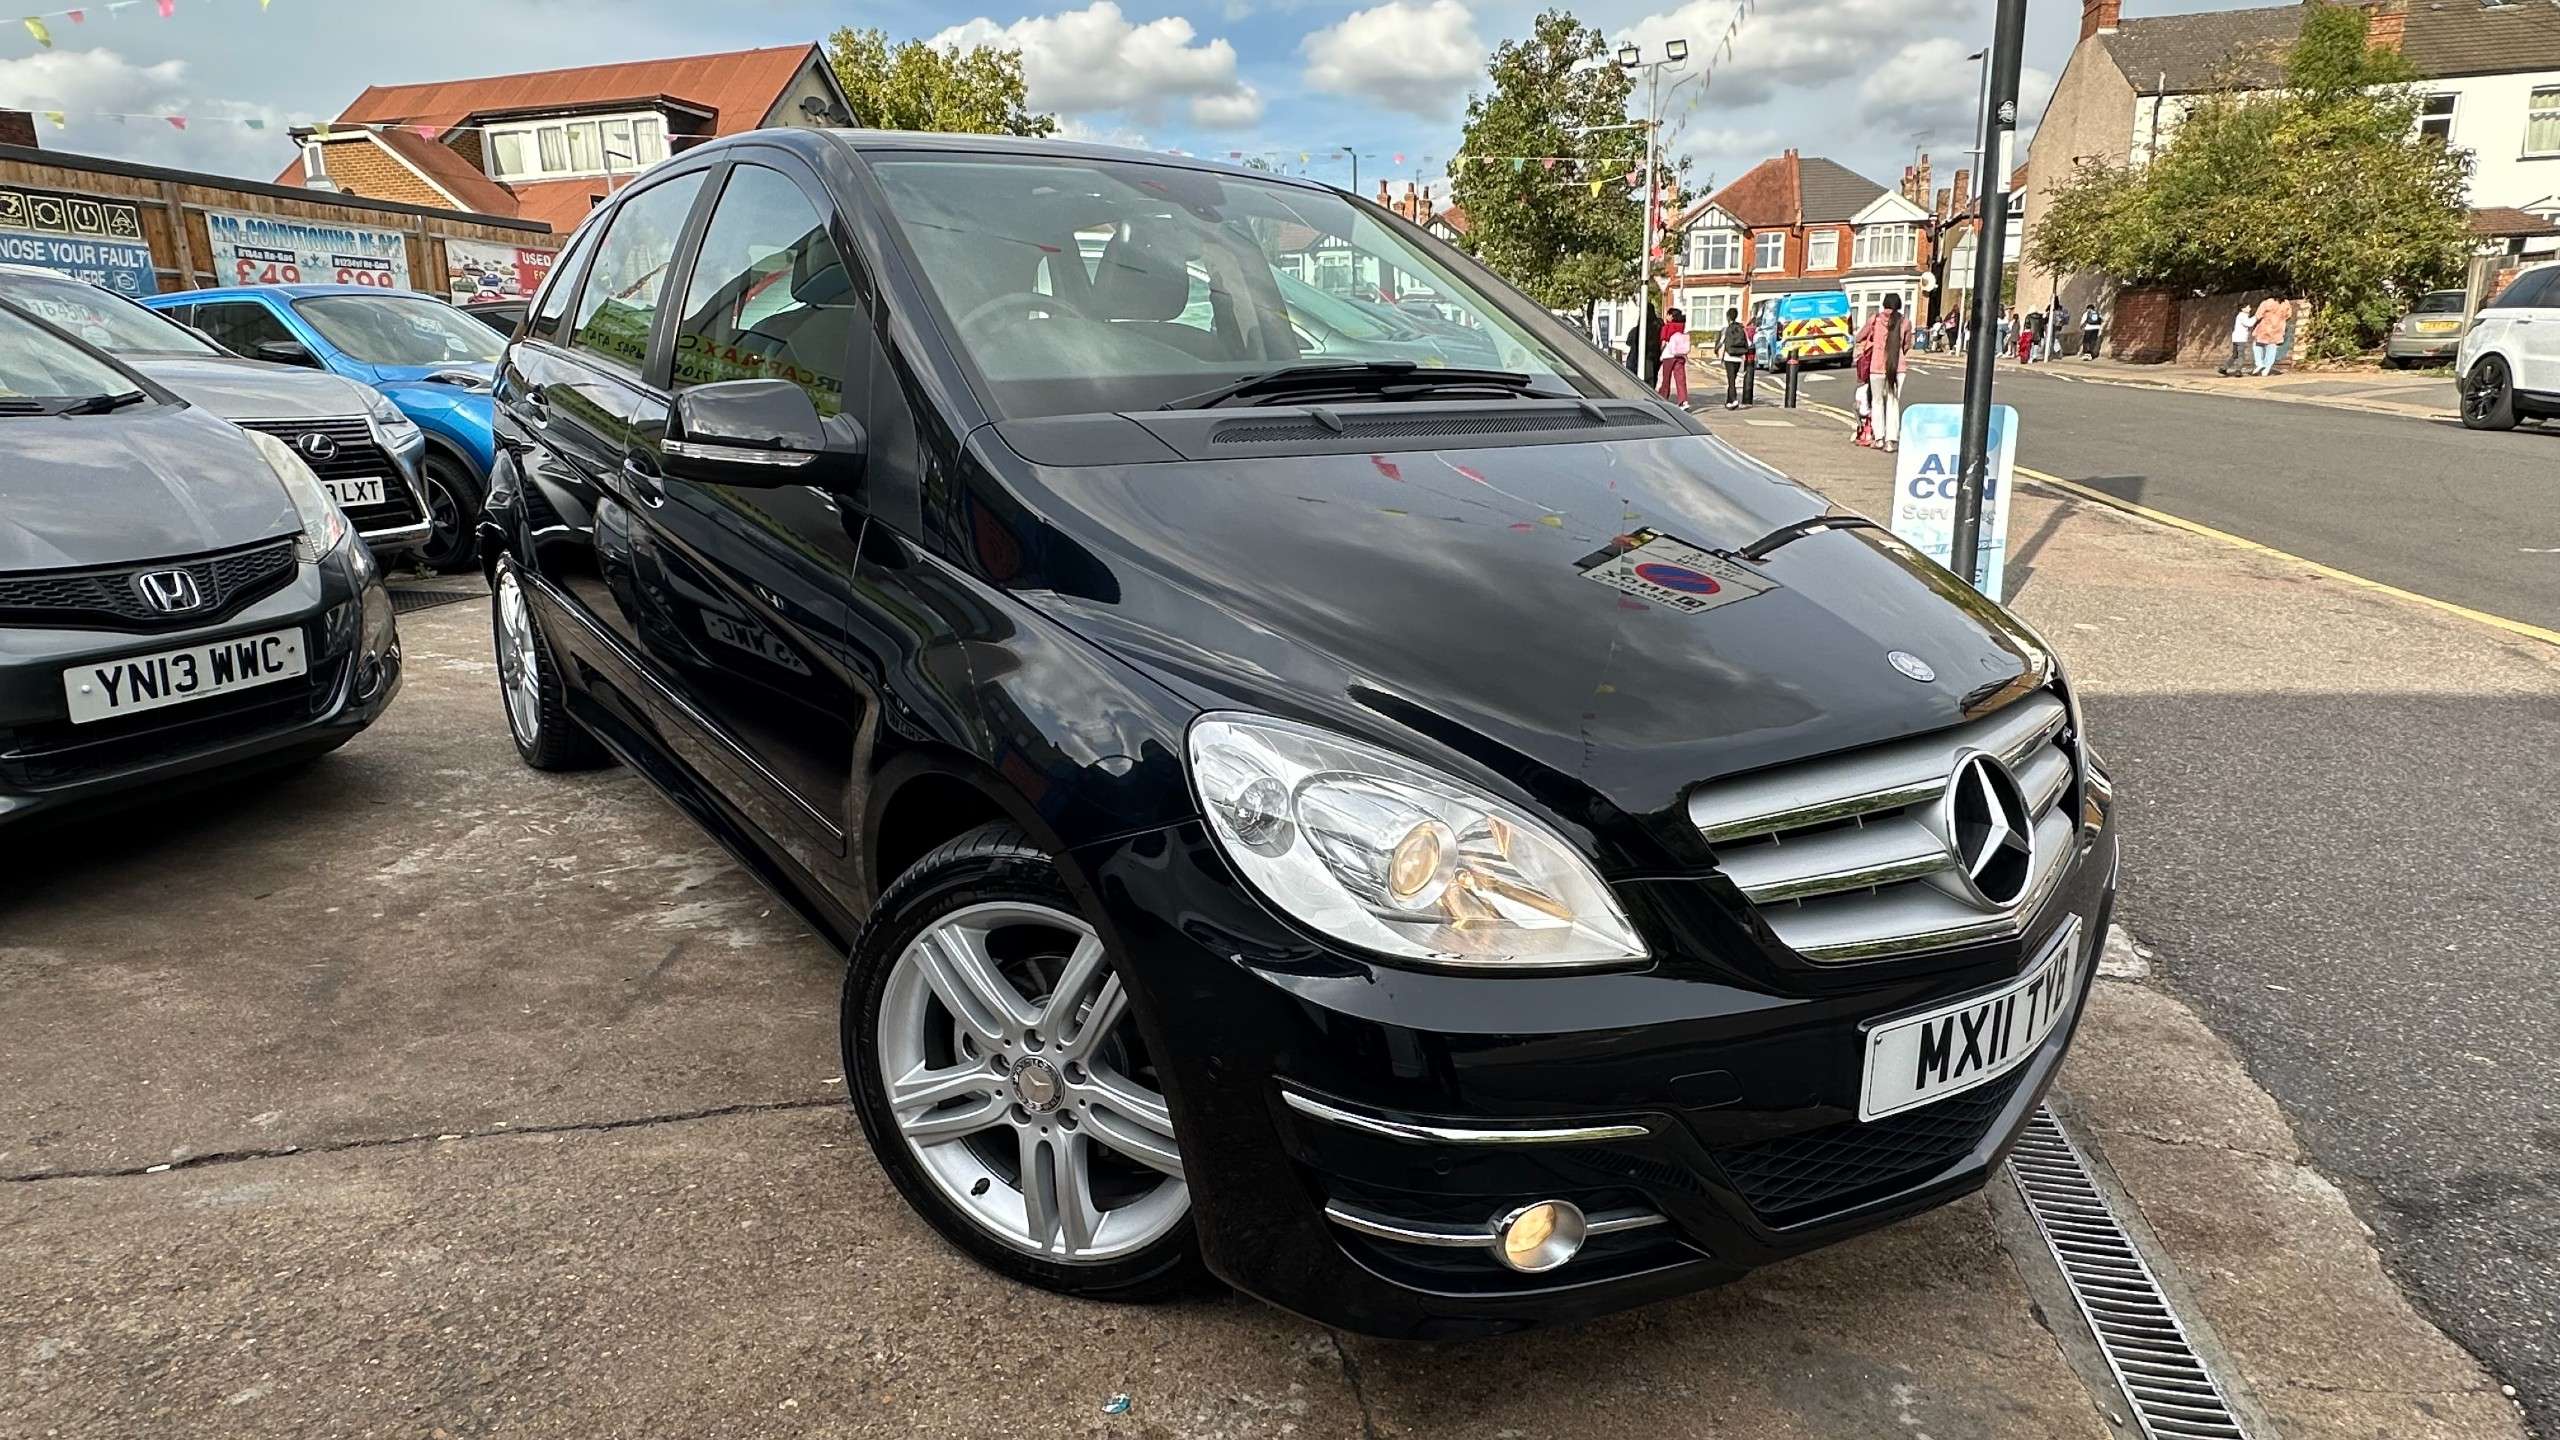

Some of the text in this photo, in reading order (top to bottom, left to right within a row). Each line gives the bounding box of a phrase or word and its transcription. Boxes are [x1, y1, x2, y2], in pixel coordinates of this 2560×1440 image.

[48, 242, 97, 265] YOUR
[522, 251, 551, 266] USED
[236, 259, 300, 286] £49
[1918, 453, 1990, 476] AI
[341, 480, 378, 502] LXT
[1908, 477, 1998, 501] CON
[96, 636, 285, 707] YN13 WWC
[1916, 947, 2069, 1091] MX11 TYB
